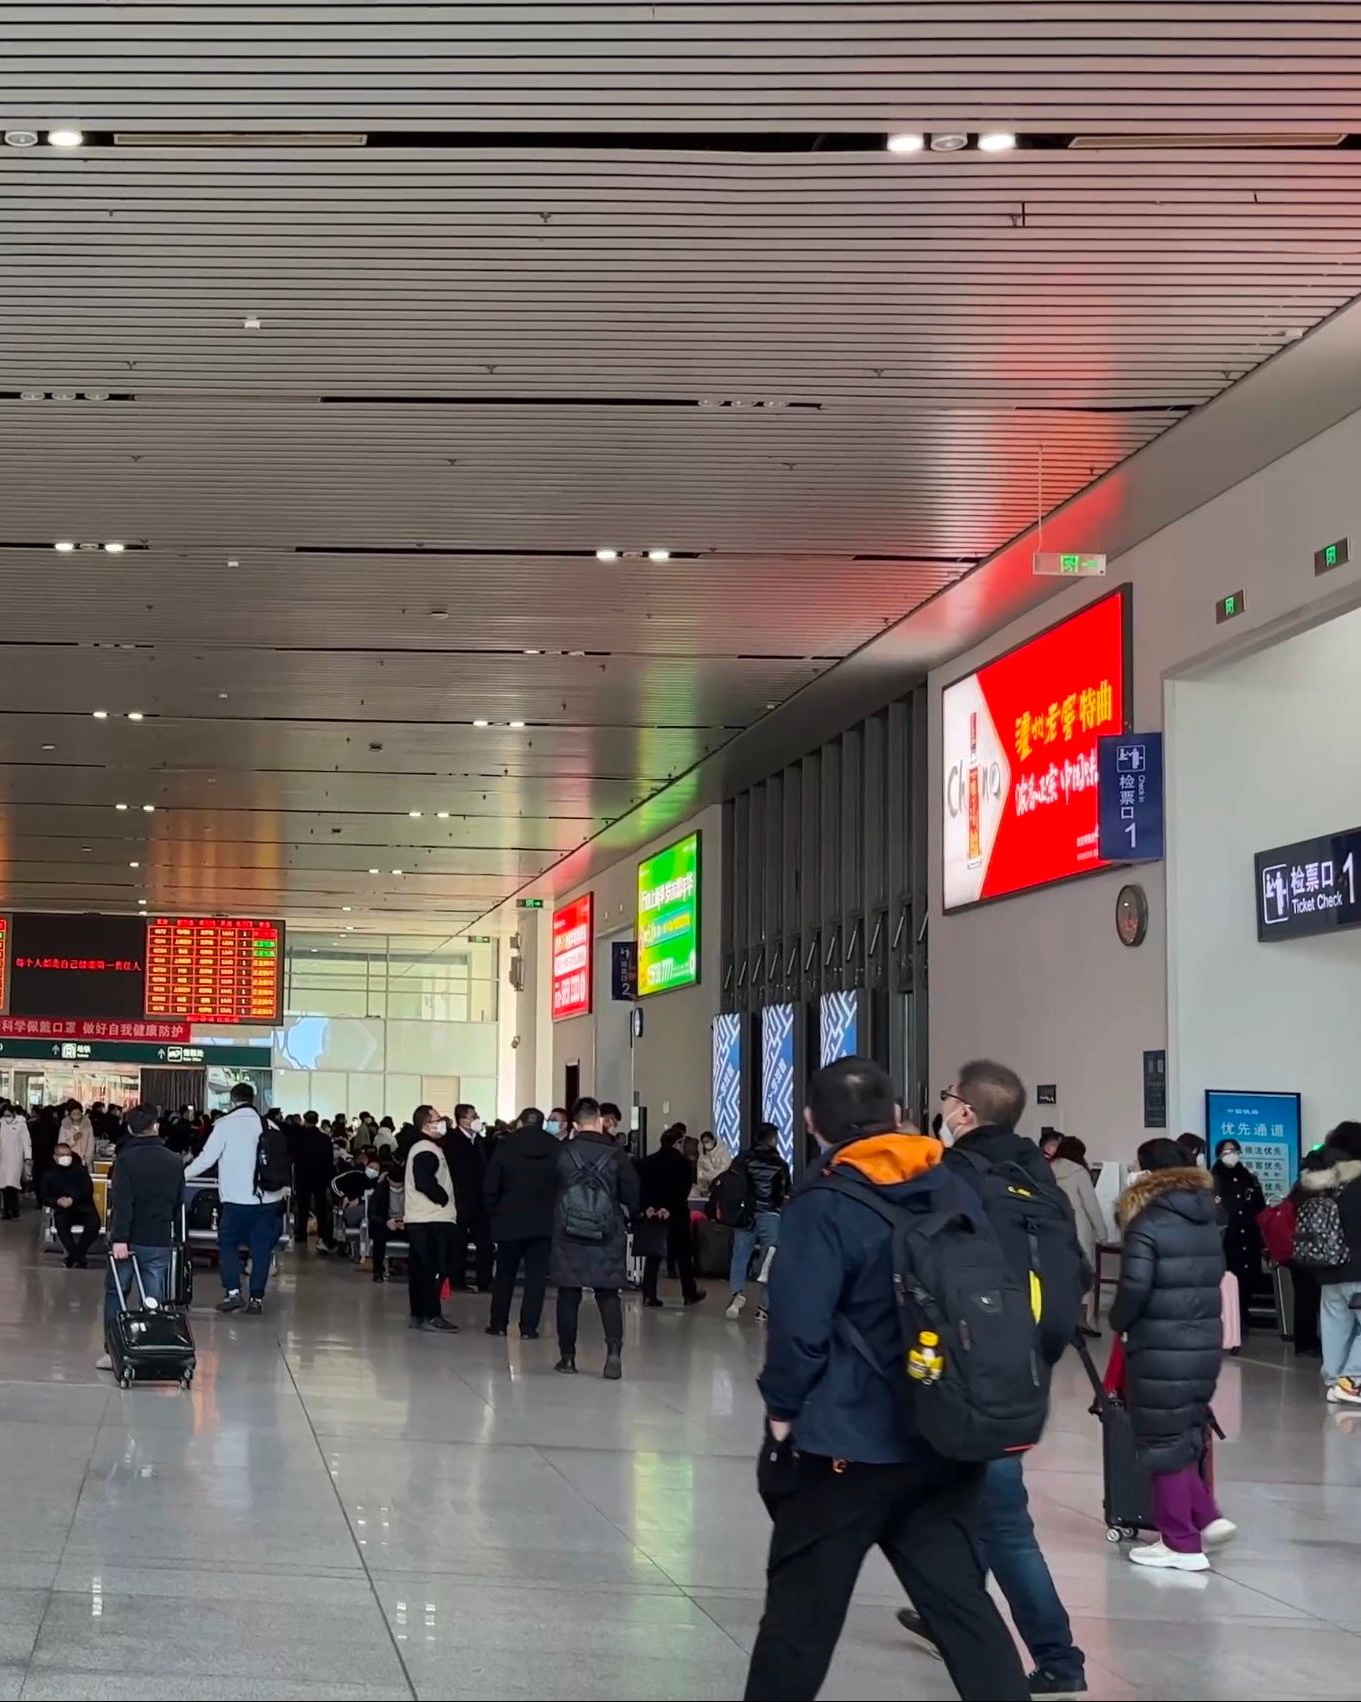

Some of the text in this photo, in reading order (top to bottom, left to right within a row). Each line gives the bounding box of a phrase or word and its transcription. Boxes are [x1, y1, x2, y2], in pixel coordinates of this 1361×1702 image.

[1119, 774, 1136, 848] 检票口 1
[1290, 851, 1356, 904] 检票口 1
[1291, 891, 1343, 914] Ticket Check
[621, 982, 631, 996] 2
[82, 1021, 183, 1038] 做好自我健康防护
[77, 1044, 91, 1054] 地铁
[1221, 1121, 1285, 1138] 优先通道
